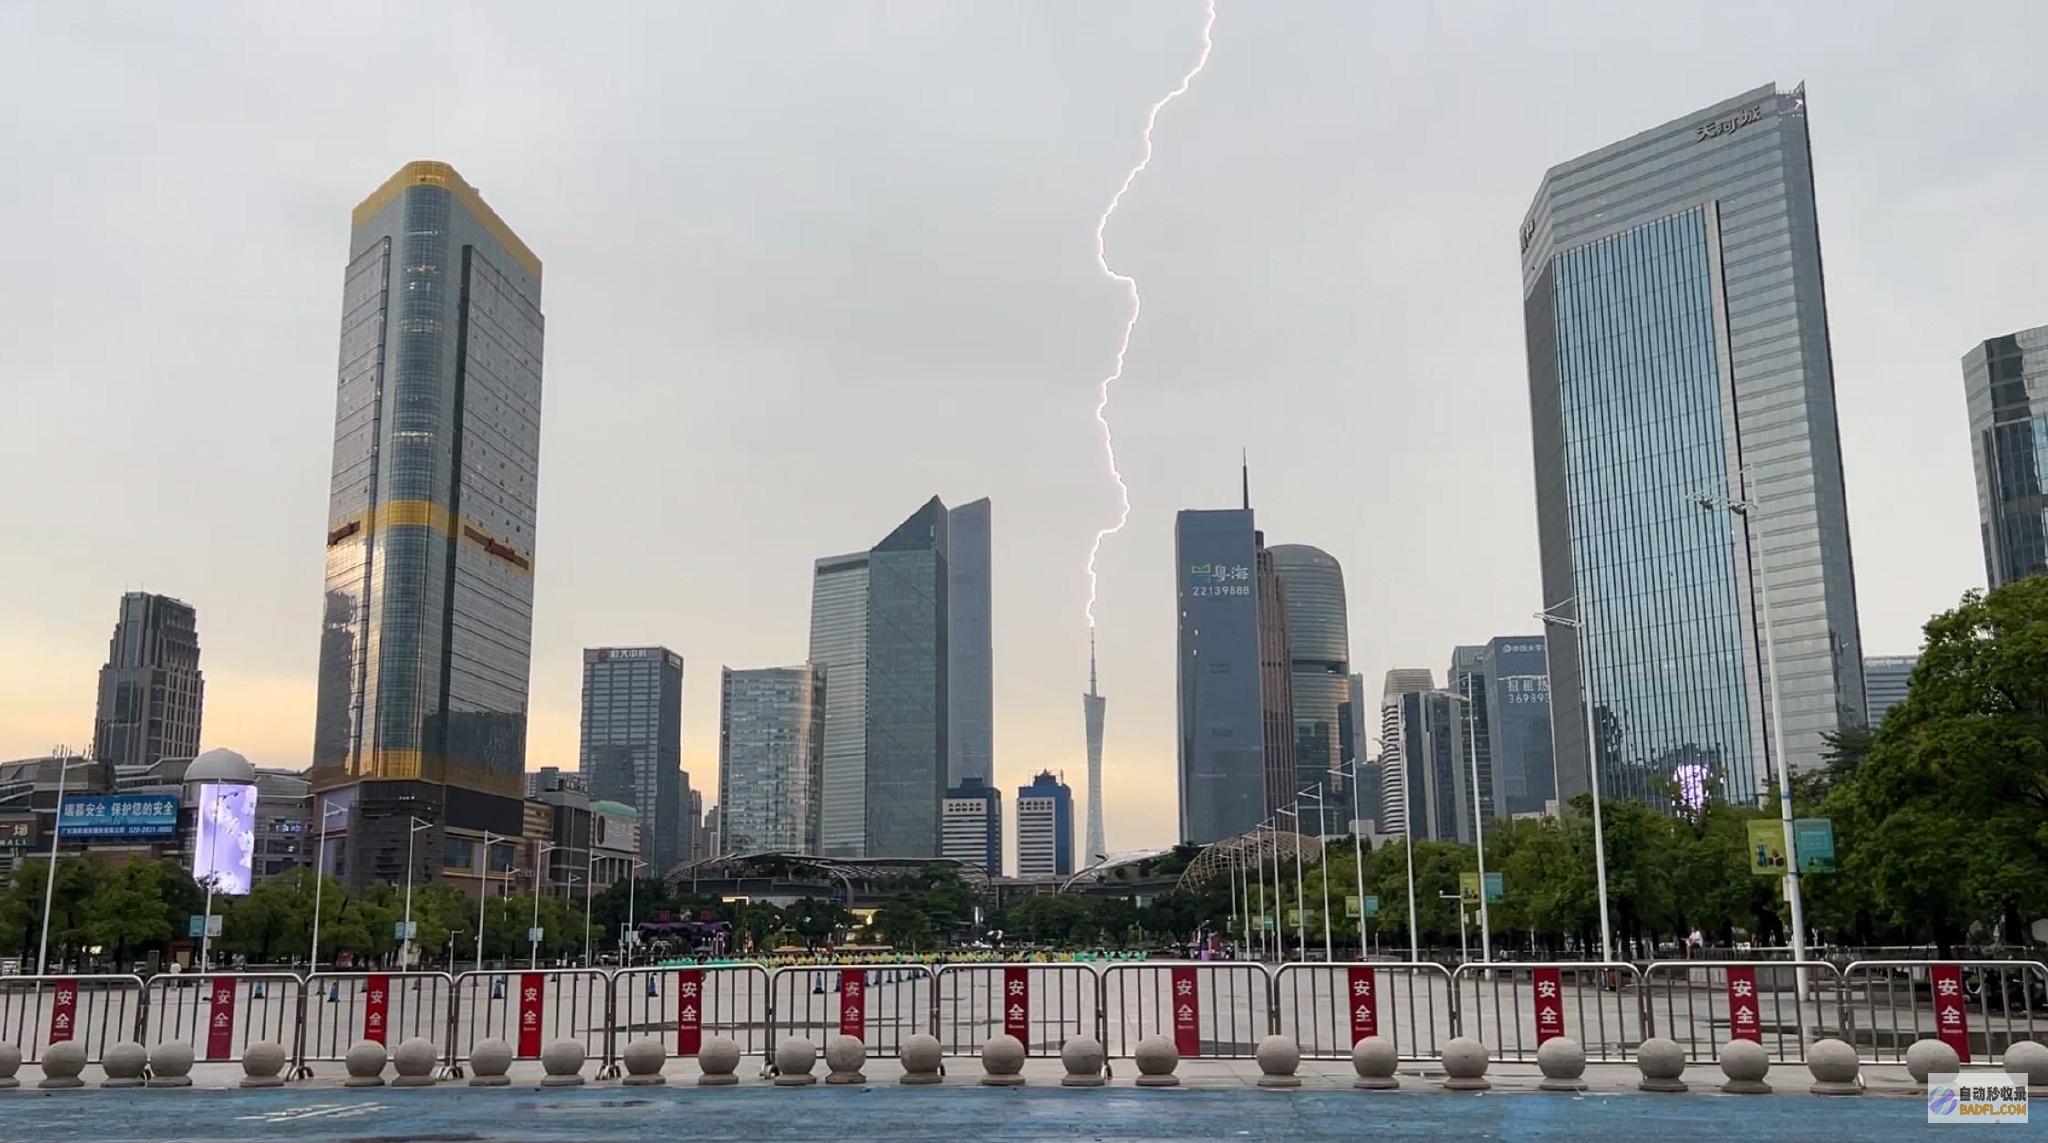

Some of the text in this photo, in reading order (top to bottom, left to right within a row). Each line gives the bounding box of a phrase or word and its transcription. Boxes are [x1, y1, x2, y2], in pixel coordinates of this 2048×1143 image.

[1697, 105, 1762, 142] 天河城
[1192, 586, 1250, 596] 22139888
[1212, 565, 1249, 581] 粤海
[111, 801, 174, 817] 保护您的安全
[57, 990, 72, 1028] 安全
[214, 989, 230, 1027] 安全
[369, 990, 383, 1025] 安全
[524, 987, 537, 1024] 安全
[682, 982, 696, 1021] 安全
[845, 982, 859, 1021] 安全
[1009, 980, 1024, 1020] 安全
[1177, 980, 1192, 1021] 安全
[1354, 980, 1371, 1022] 安全
[1538, 980, 1557, 1024] 安全
[1733, 980, 1755, 1024] 安全
[1938, 978, 1960, 1024] 安全
